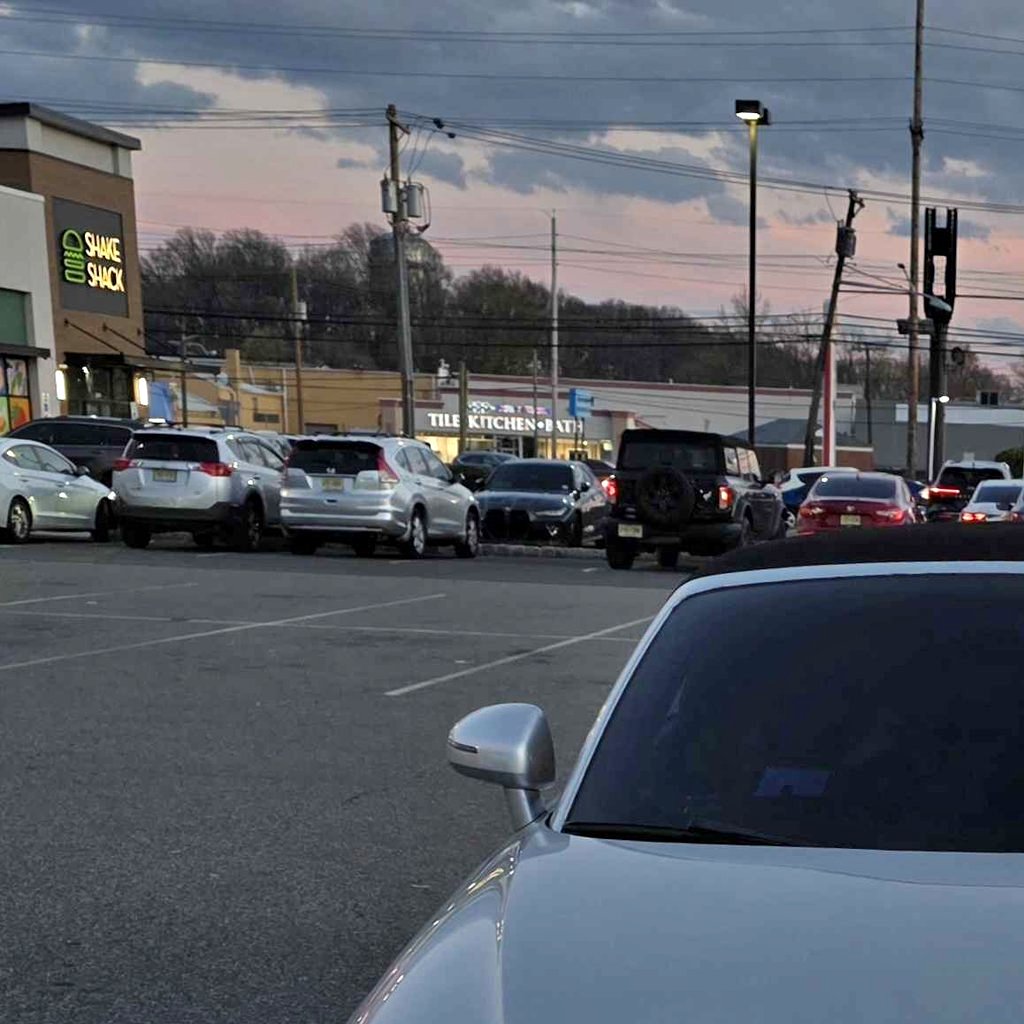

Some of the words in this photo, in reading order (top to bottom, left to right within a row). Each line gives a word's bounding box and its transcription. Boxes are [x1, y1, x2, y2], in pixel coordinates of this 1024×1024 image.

[84, 232, 121, 262] SHAKE
[87, 262, 125, 292] SHACK
[427, 413, 460, 428] TILE
[468, 415, 536, 432] KITCHEN
